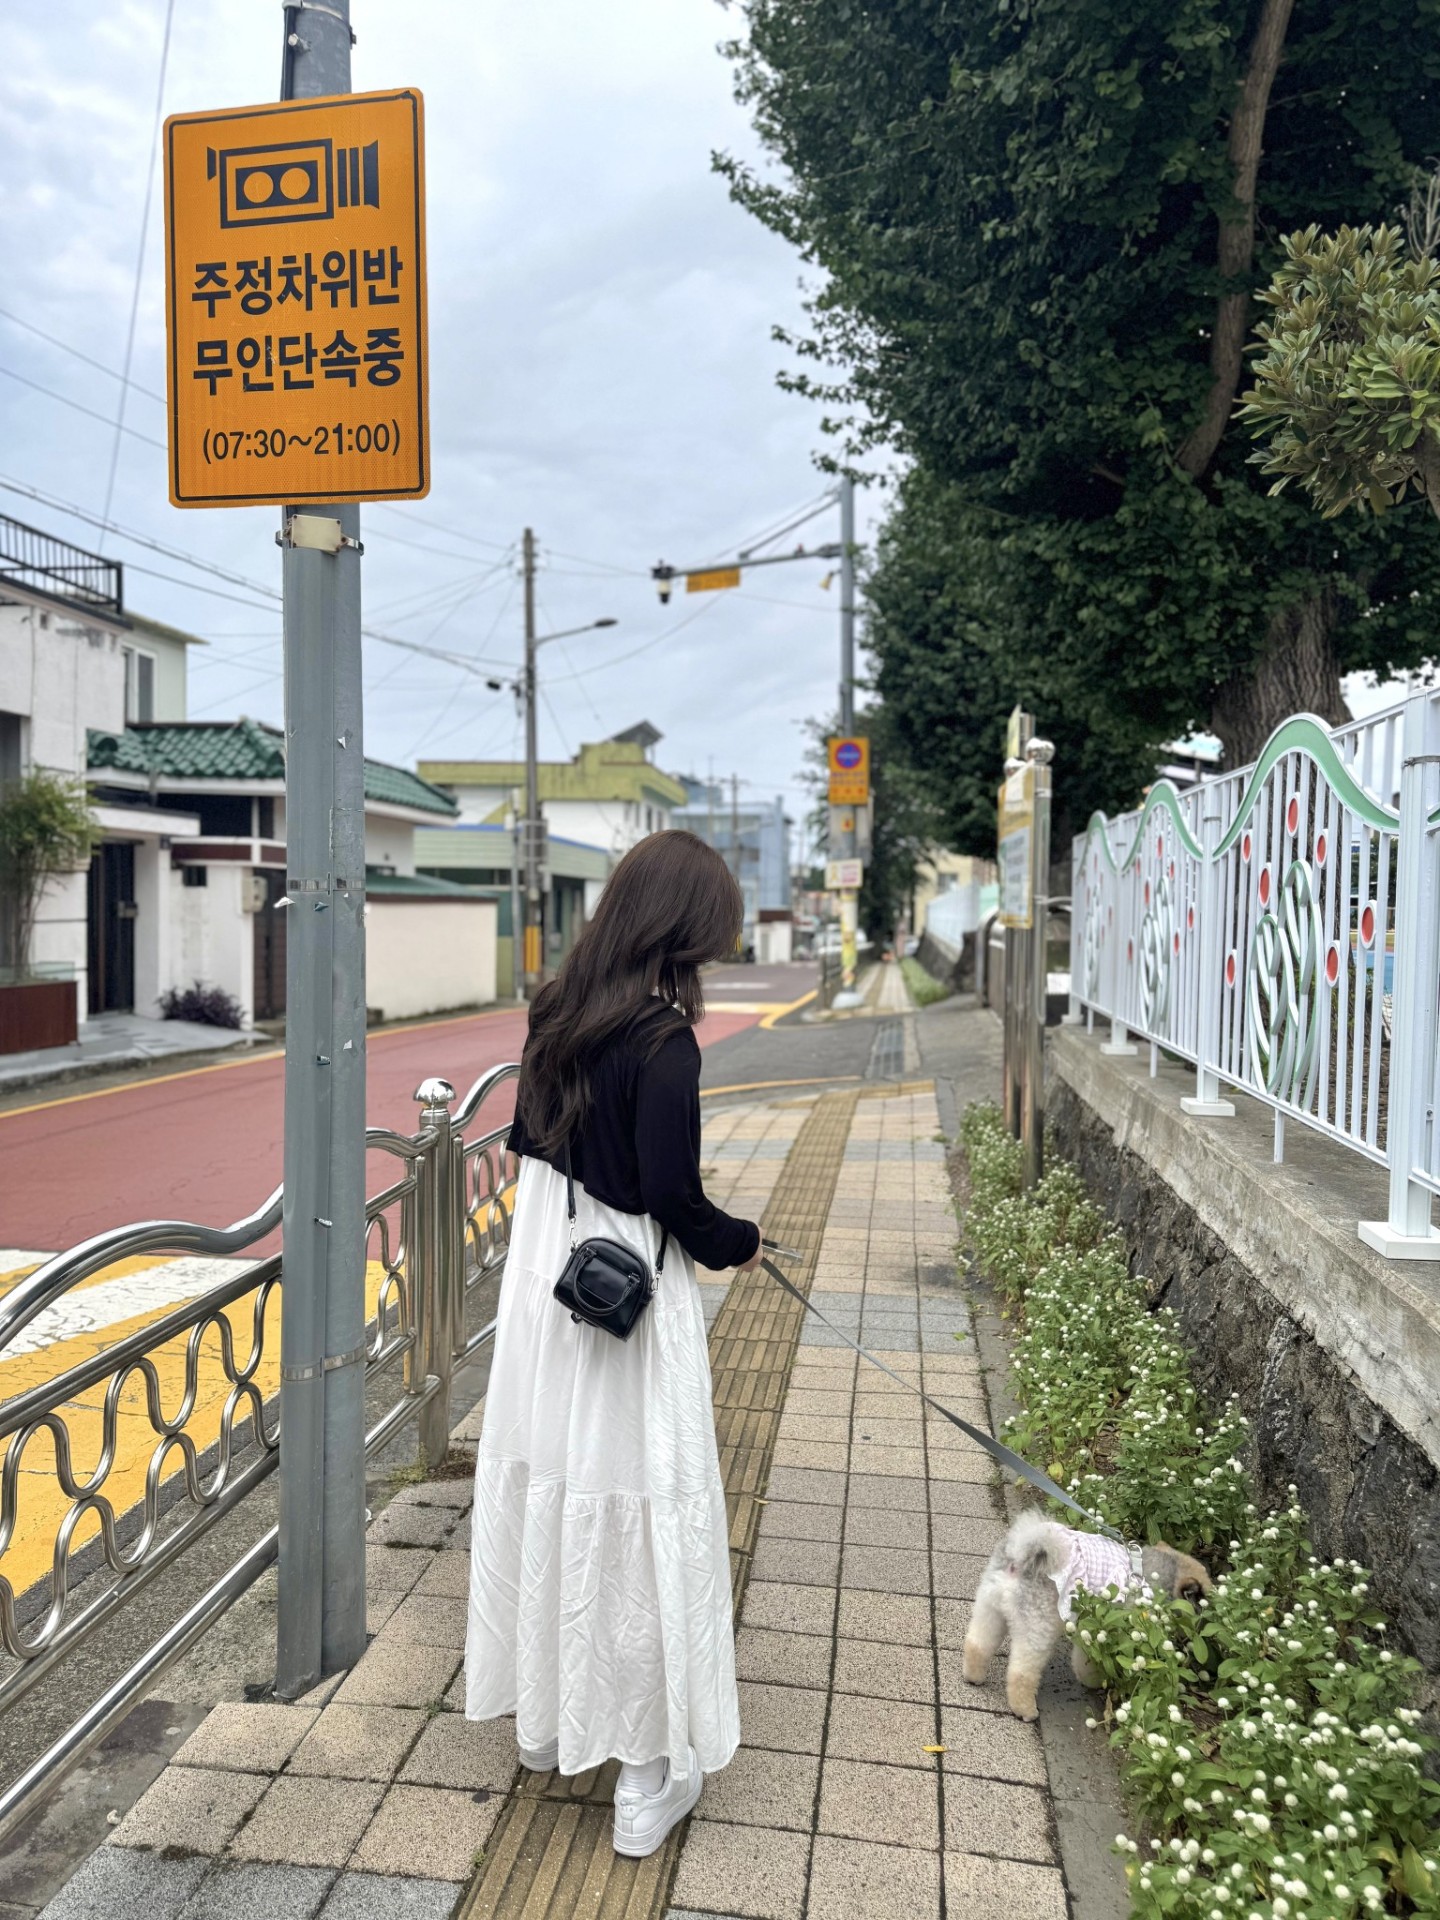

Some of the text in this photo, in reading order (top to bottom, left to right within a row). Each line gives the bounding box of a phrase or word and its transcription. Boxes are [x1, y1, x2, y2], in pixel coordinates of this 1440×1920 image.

[191, 245, 404, 319] 주정차위반
[193, 327, 405, 396] 무인단속중
[202, 418, 401, 465] (07:30~21:00)
